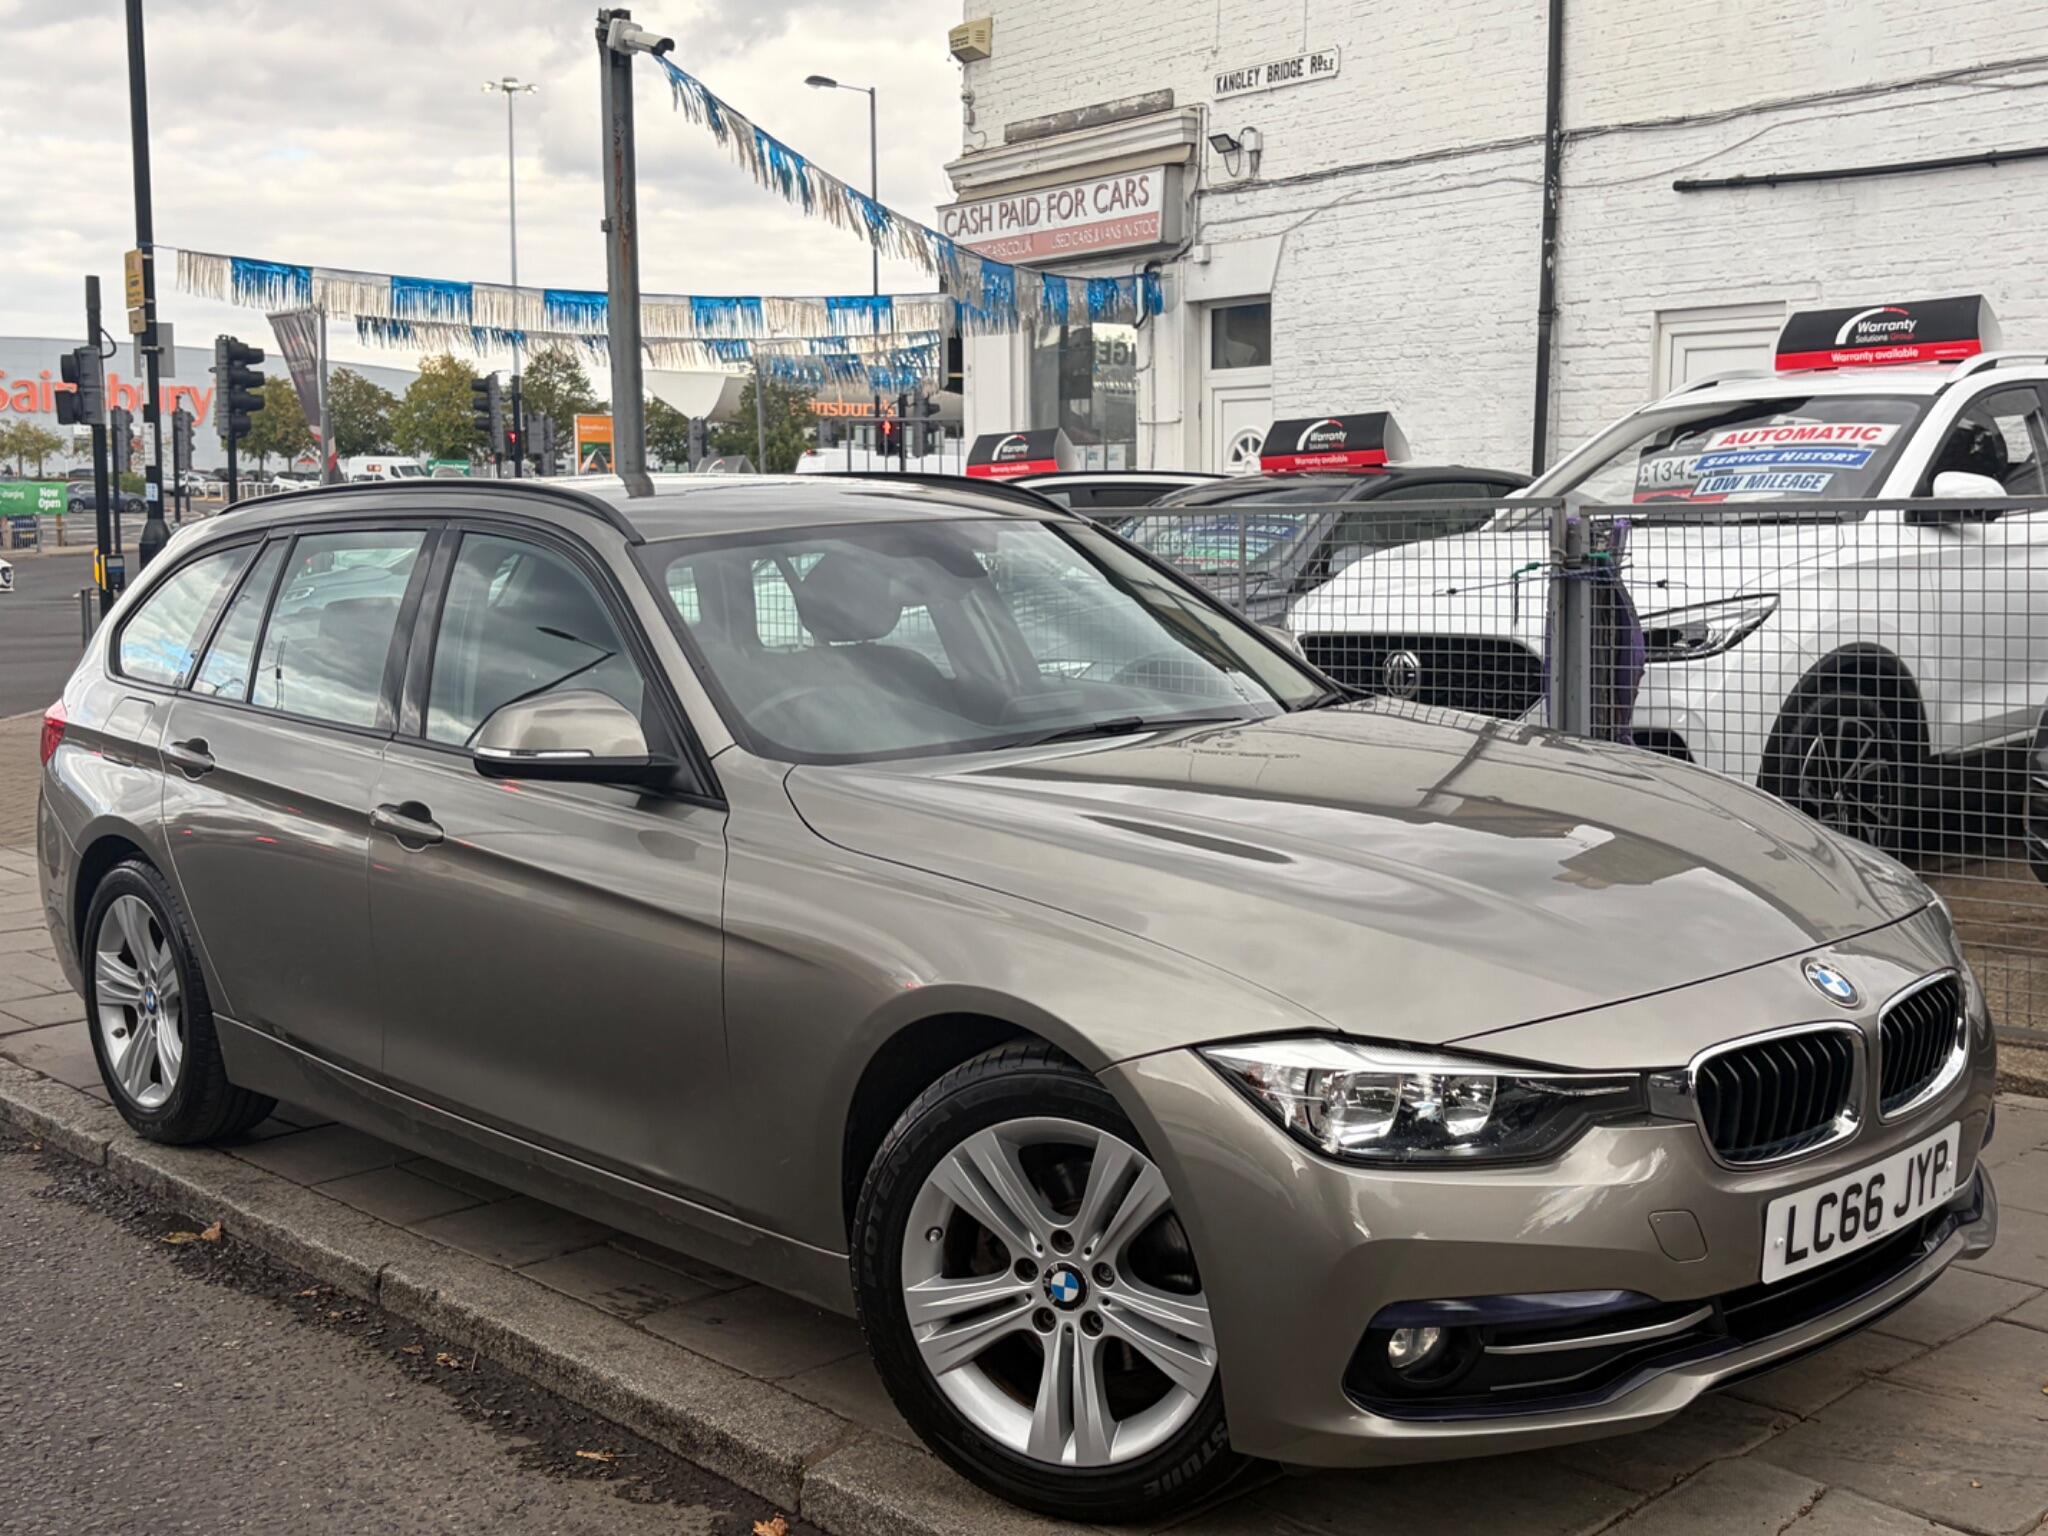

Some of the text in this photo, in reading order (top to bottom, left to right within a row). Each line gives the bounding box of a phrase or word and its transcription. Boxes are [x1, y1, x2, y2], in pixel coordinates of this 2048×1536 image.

[1215, 67, 1261, 94] KANGLEY
[1266, 58, 1305, 83] BRIDGE
[944, 174, 1150, 237] CASH PAID FOR CARS
[1071, 228, 1092, 246] CARS
[1857, 318, 1918, 333] Warranty
[1855, 333, 1889, 343] Solutions
[1831, 348, 1919, 363] Warranty available
[0, 369, 214, 427] aibry
[1309, 430, 1348, 442] Warranty
[1718, 426, 1883, 446] AUTOMATIC
[1294, 454, 1349, 465] Warranty available
[1703, 450, 1858, 467] SERVICE HISTORY
[1701, 473, 1826, 492] LOW MILEAGE
[39, 487, 59, 498] Now
[38, 498, 61, 511] Open
[1785, 1139, 1948, 1265] LC66 JYP
